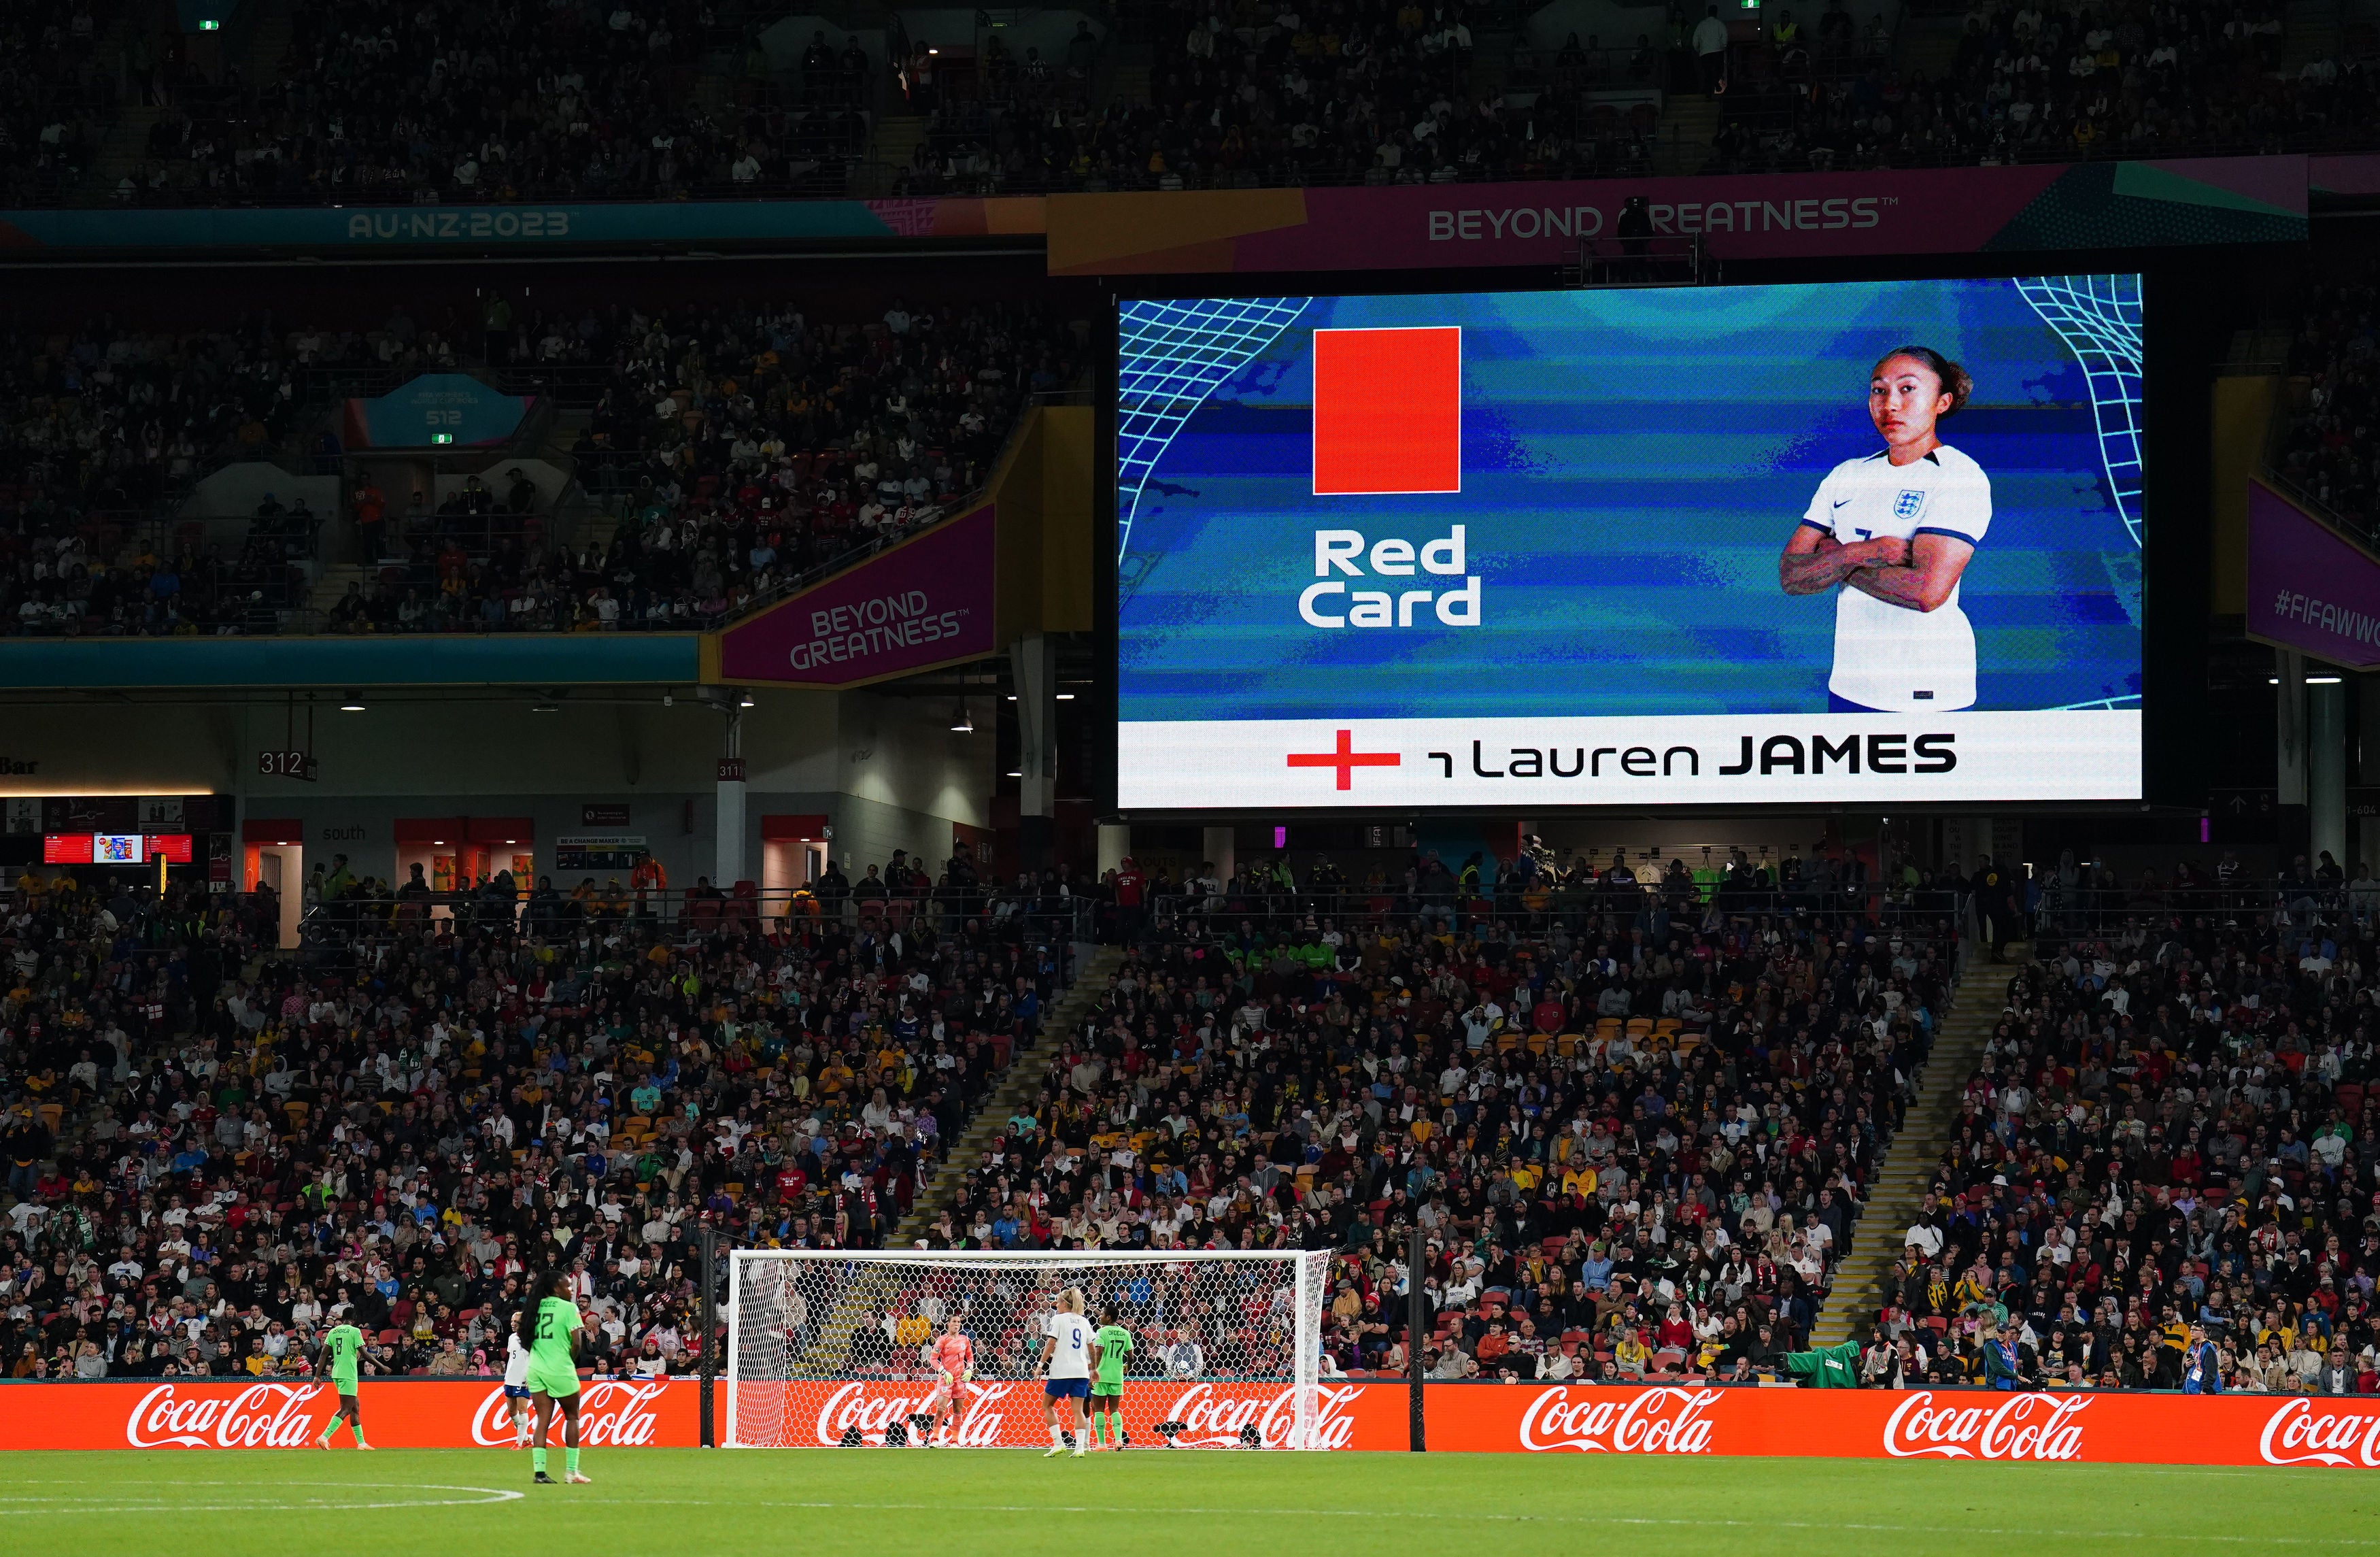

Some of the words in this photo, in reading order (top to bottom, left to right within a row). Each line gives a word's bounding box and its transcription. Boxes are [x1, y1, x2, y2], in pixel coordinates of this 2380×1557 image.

[1429, 207, 1603, 241] BEYOND
[426, 410, 462, 425] 512
[1314, 524, 1466, 577] Red
[811, 590, 928, 638] BEYOND
[1297, 575, 1482, 629] Card
[260, 752, 302, 773] 312
[1473, 740, 1699, 778] Lauren
[1719, 733, 1958, 775] JAMES
[719, 765, 739, 777] 311
[322, 824, 365, 840] south
[336, 1337, 343, 1355] 8
[1072, 1328, 1081, 1349] 9
[1110, 1339, 1125, 1359] 17
[512, 1350, 517, 1360] 5
[126, 1383, 325, 1448] Coca-Cola
[1520, 1386, 1724, 1453] Coca-Cola
[1883, 1391, 2094, 1460] Coca-Cola
